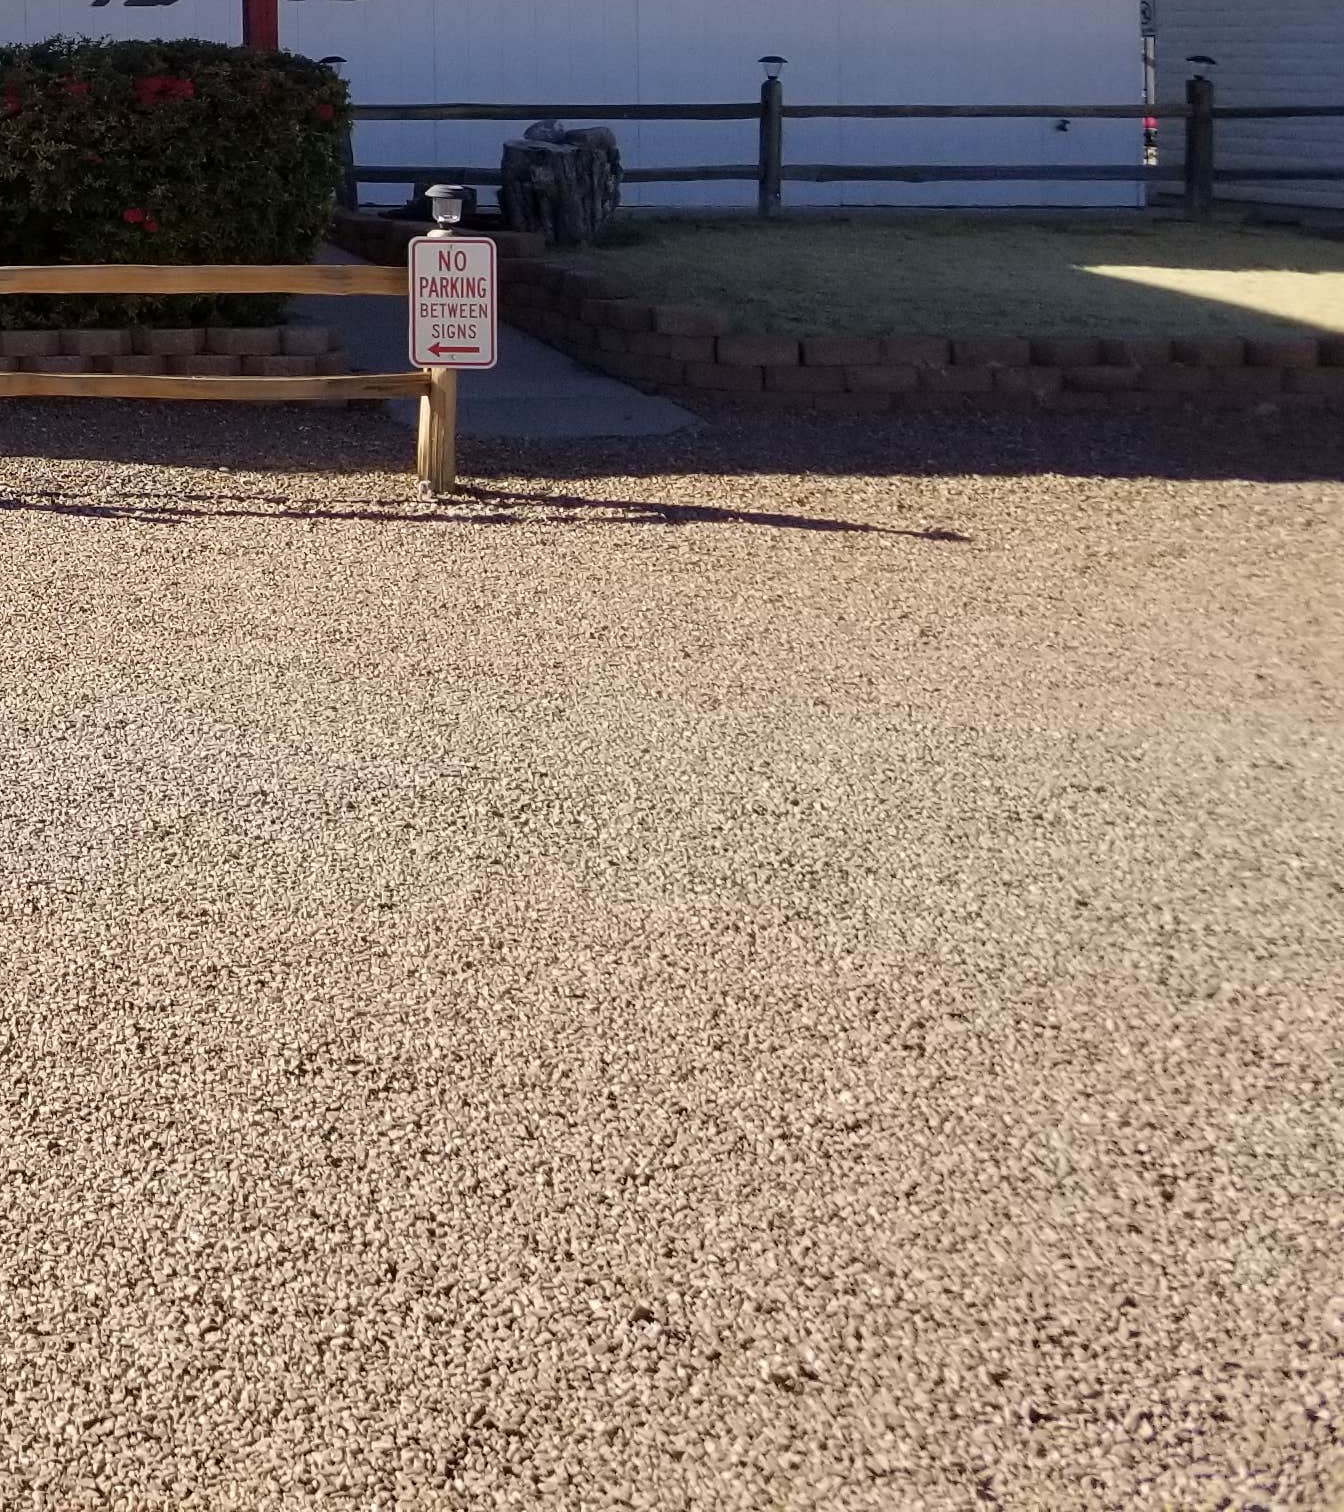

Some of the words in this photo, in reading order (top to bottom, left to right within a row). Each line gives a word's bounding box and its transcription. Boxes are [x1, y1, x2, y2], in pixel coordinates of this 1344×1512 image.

[438, 250, 467, 271] NO
[419, 276, 487, 299] PARKING
[419, 303, 488, 319] BETWEEN
[431, 324, 477, 339] SIGNS
